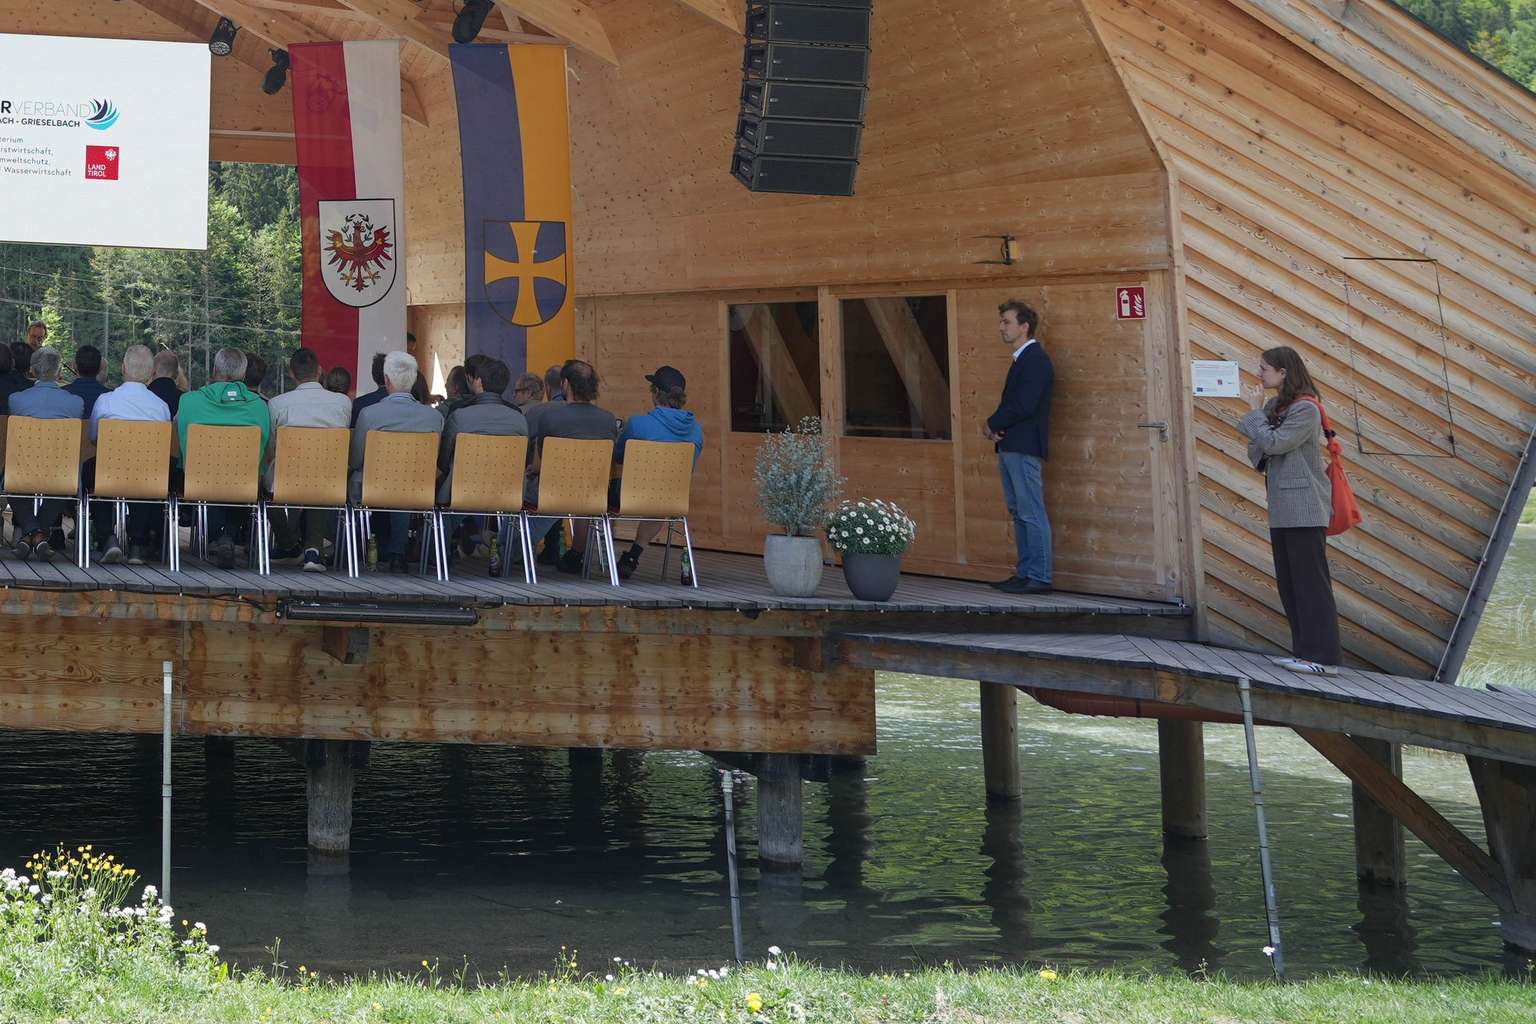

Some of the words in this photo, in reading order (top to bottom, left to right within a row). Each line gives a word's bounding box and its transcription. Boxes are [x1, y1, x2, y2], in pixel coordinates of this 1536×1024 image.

[21, 117, 81, 127] GRIESELBACH
[4, 166, 72, 177] Wasserwirtschaft
[87, 163, 106, 171] LAND
[87, 170, 107, 178] TIROL
